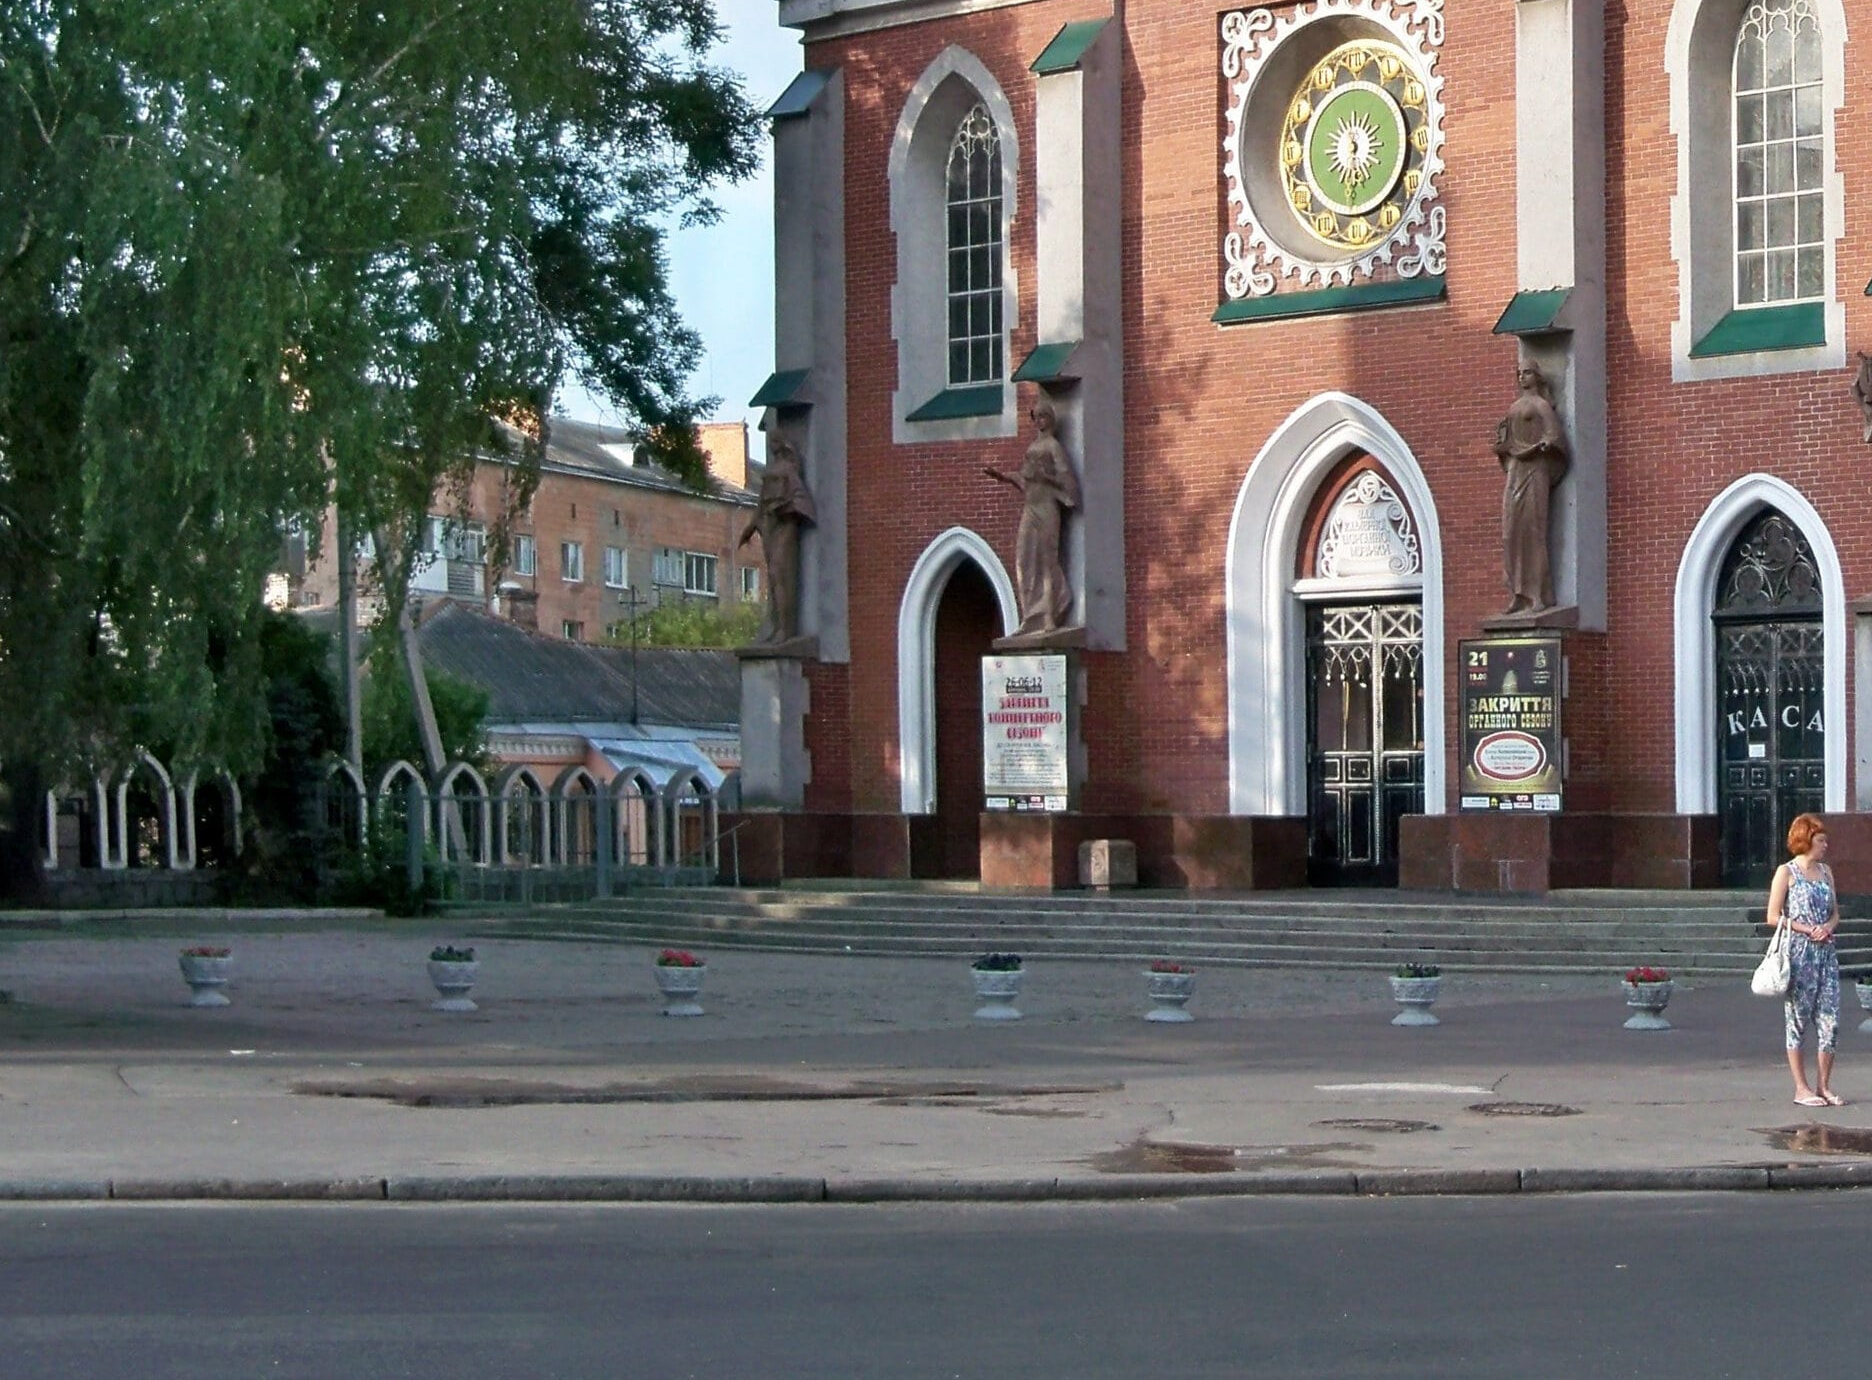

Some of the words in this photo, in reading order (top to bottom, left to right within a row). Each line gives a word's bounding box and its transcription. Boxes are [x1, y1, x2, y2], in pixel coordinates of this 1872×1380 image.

[1468, 651, 1488, 666] 21
[1469, 696, 1552, 713] ЗАКРИТТЯ
[1468, 713, 1517, 729] ОРГАННОГО
[1727, 705, 1825, 736] КАСА
